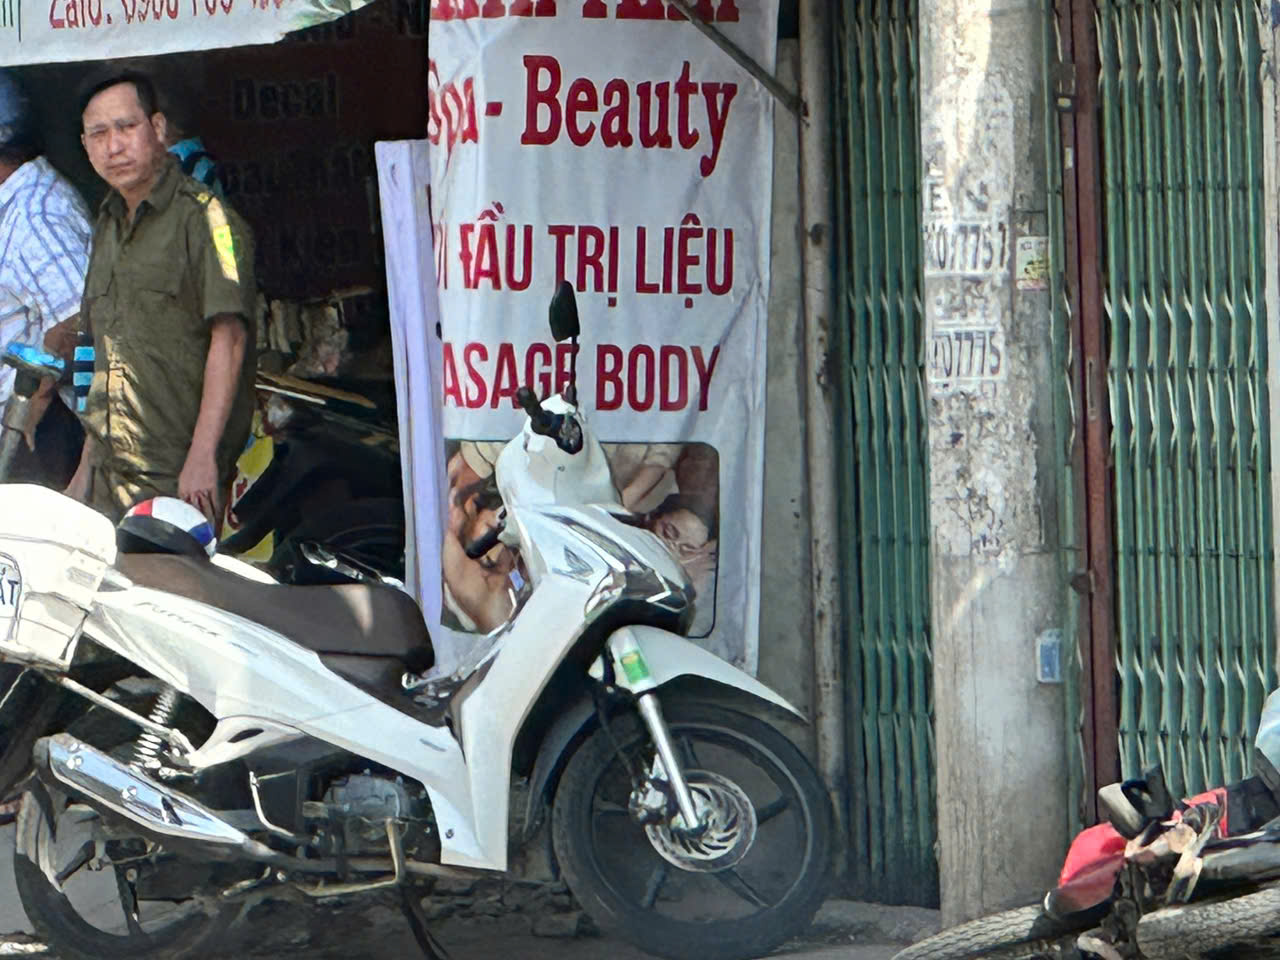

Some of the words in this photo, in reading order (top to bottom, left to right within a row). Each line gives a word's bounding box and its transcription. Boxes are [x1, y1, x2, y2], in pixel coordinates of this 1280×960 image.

[521, 54, 738, 178] Beauty
[547, 224, 619, 308] TRỊ
[636, 212, 734, 309] LIỆU
[441, 341, 581, 411] ASAGE
[595, 344, 720, 412] BODY
